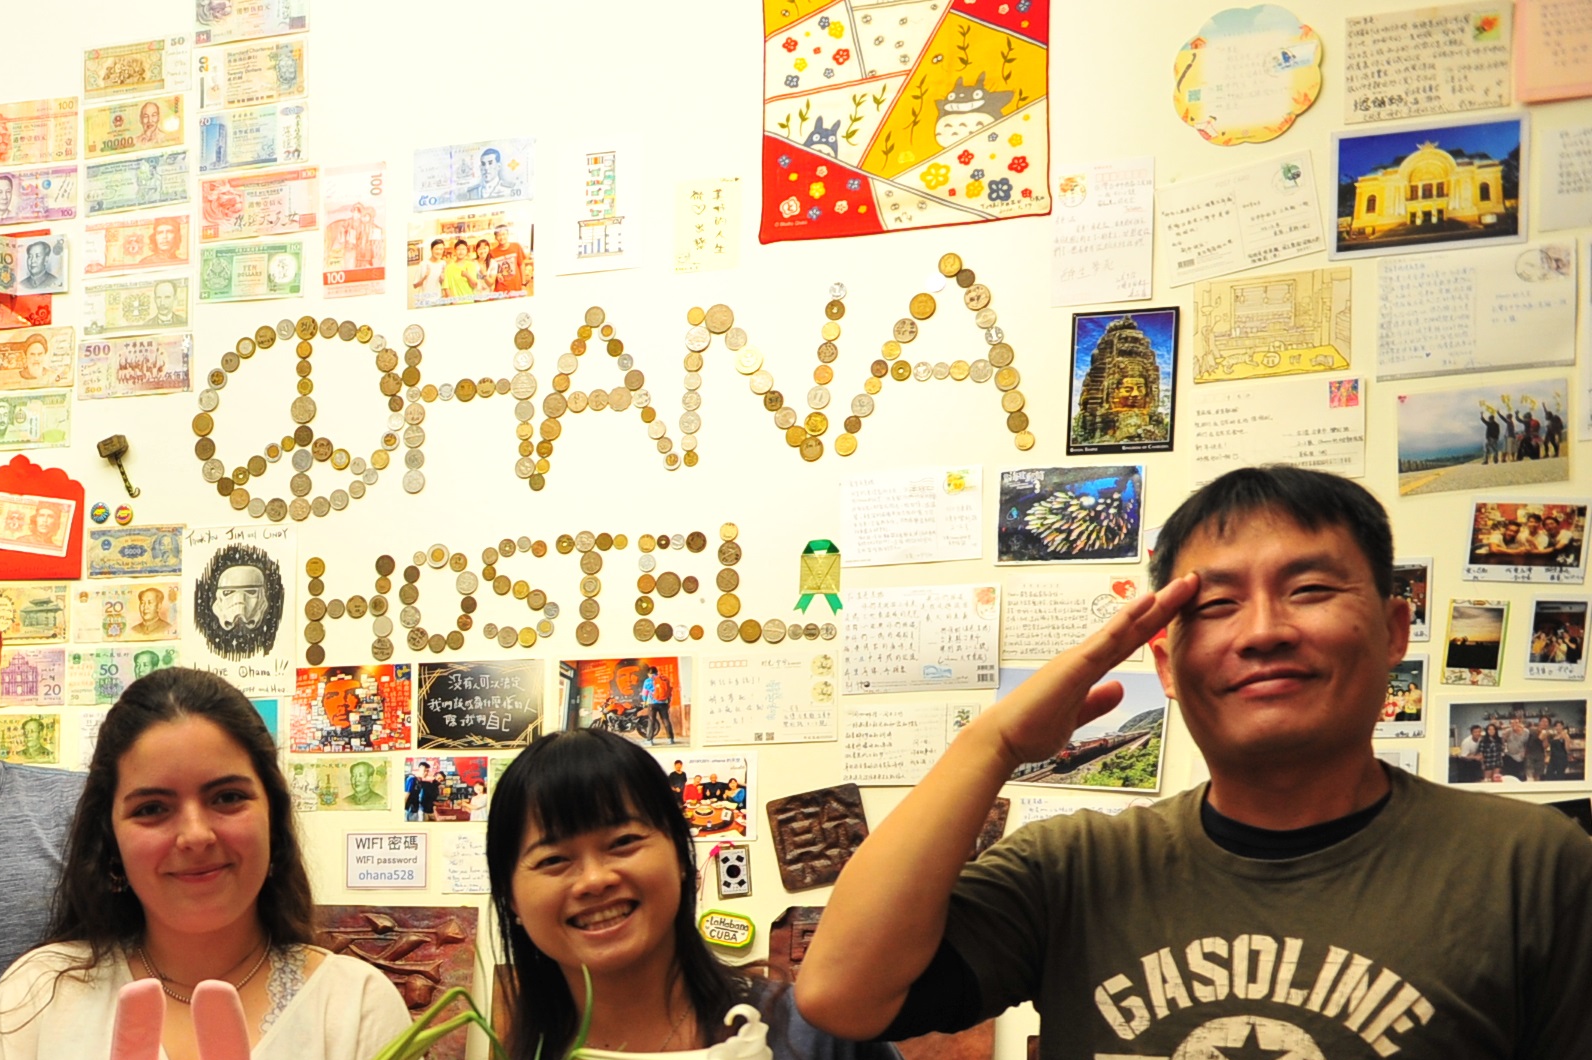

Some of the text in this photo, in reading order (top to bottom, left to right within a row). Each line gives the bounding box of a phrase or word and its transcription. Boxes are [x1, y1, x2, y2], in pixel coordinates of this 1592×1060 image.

[169, 36, 185, 46] 50
[199, 56, 208, 72] 20
[100, 136, 134, 149] 10000
[370, 173, 383, 196] 100
[510, 189, 522, 198] 50
[60, 209, 73, 217] 100
[326, 271, 345, 284] 100
[84, 344, 111, 358] 500
[124, 341, 154, 349] 中華民國
[226, 527, 245, 541] JIM
[303, 520, 837, 667] HOSTEL
[104, 601, 124, 614] 20
[99, 664, 119, 676] 50
[43, 684, 62, 696] 20
[355, 835, 418, 851] WIFI 密碼
[356, 855, 418, 866] WIFI password
[358, 869, 414, 881] ohana528
[709, 928, 738, 942] CUBA
[1094, 933, 1436, 1059] GASOLINE
